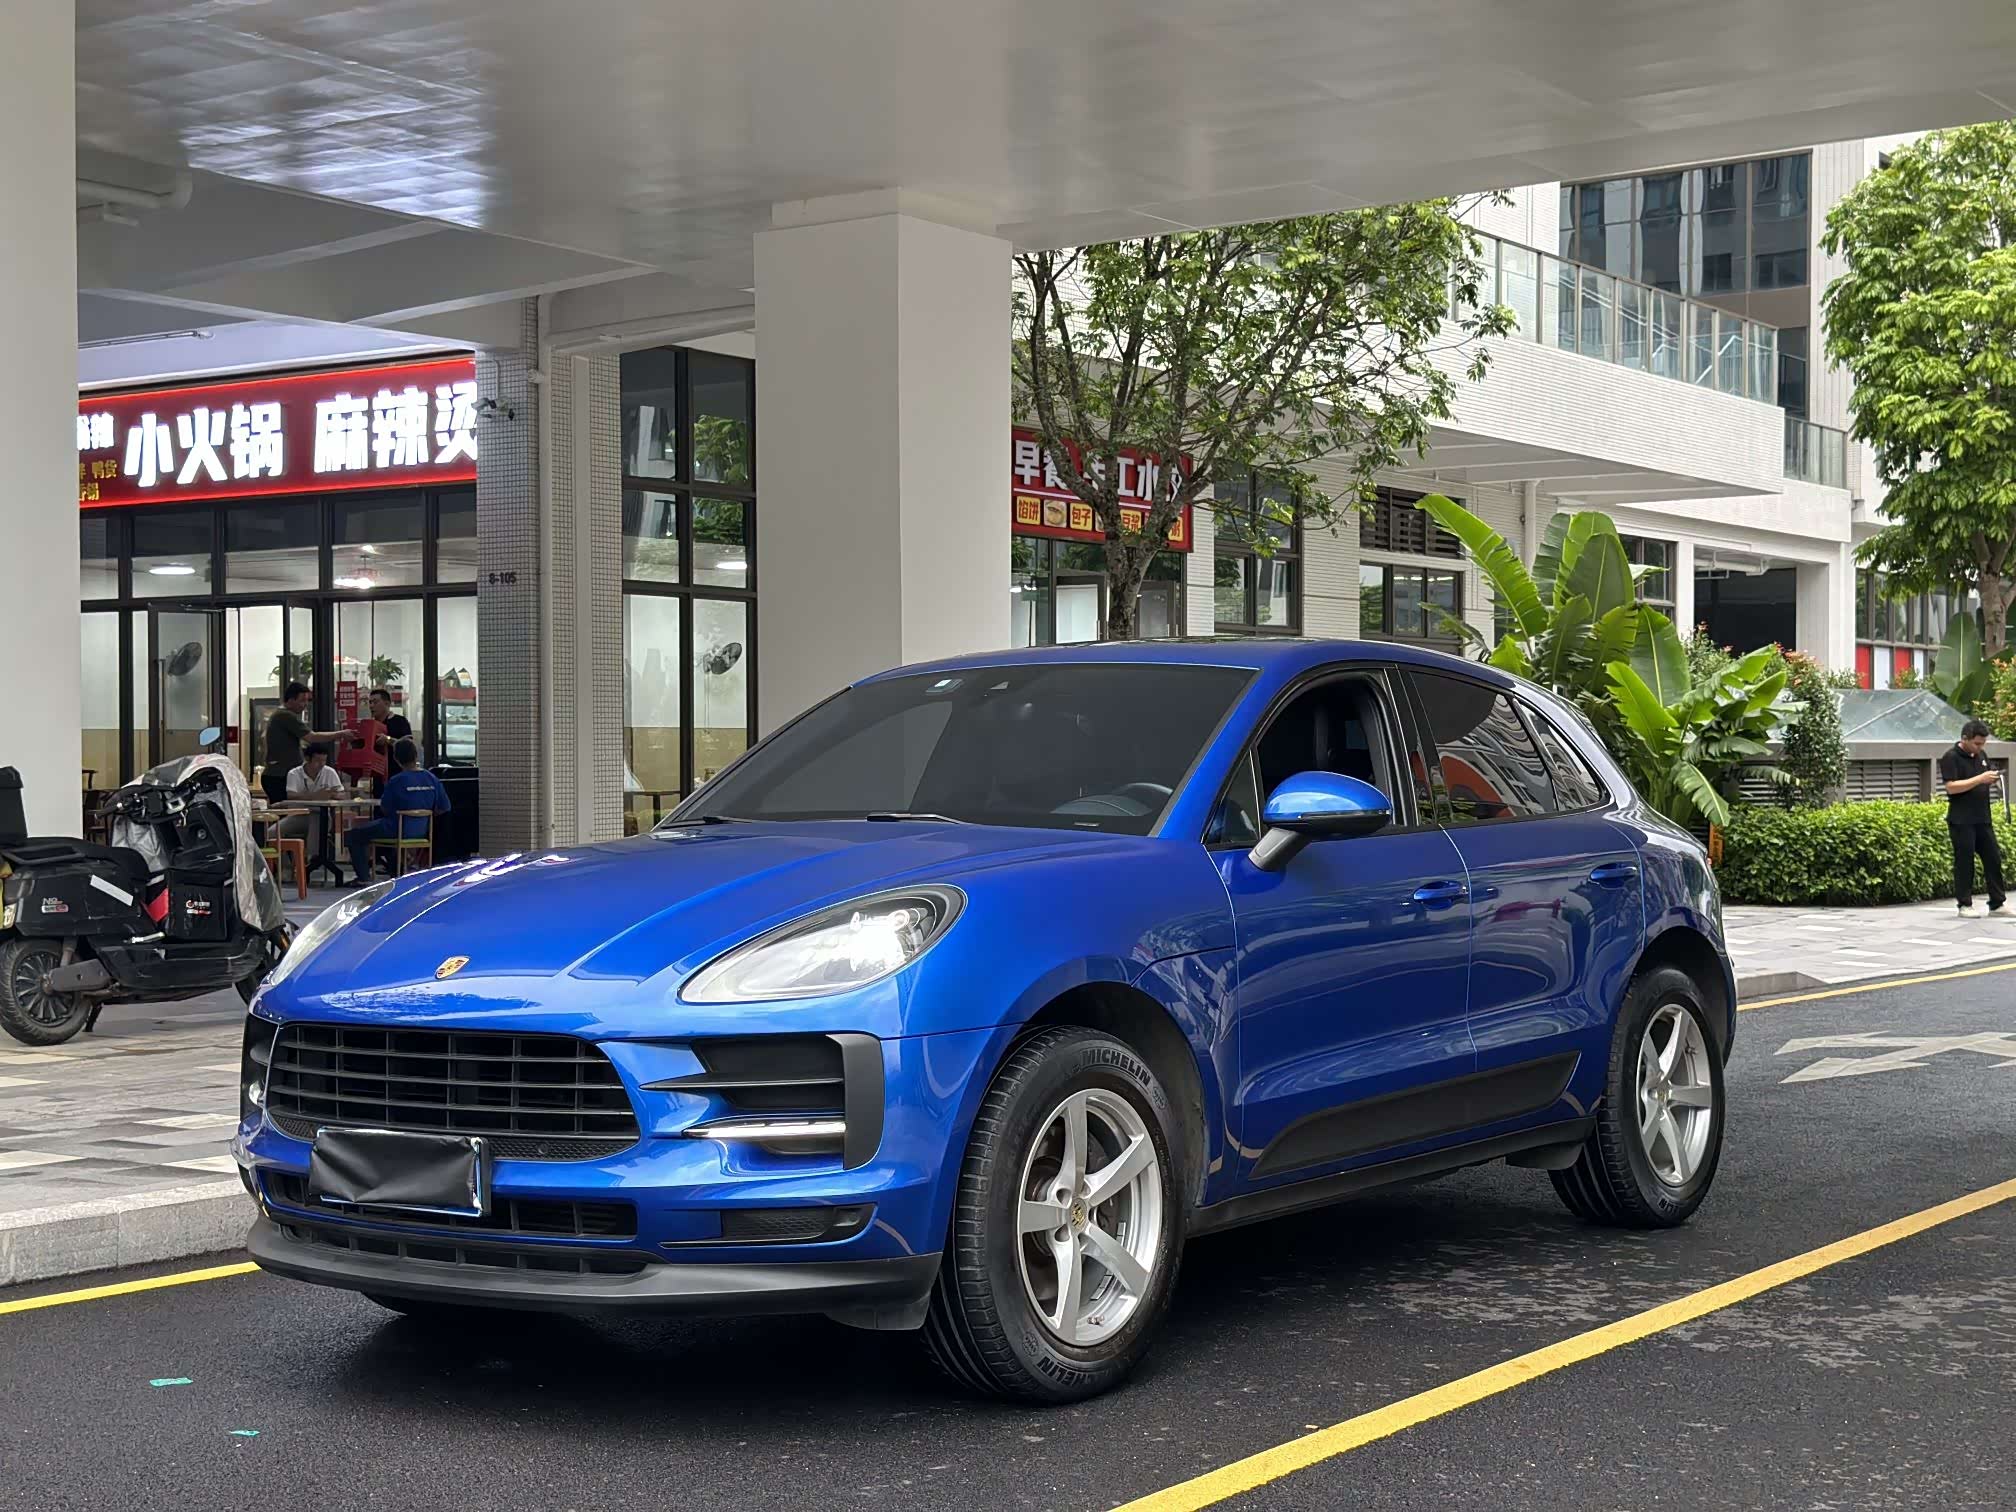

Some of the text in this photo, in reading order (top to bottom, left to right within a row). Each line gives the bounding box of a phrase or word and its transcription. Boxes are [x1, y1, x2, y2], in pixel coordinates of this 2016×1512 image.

[124, 402, 283, 488] 小火锅
[314, 381, 478, 473] 麻辣烫
[1072, 506, 1091, 527] 包子
[489, 571, 517, 585] 8-105
[1081, 1048, 1151, 1087] MICHELIN
